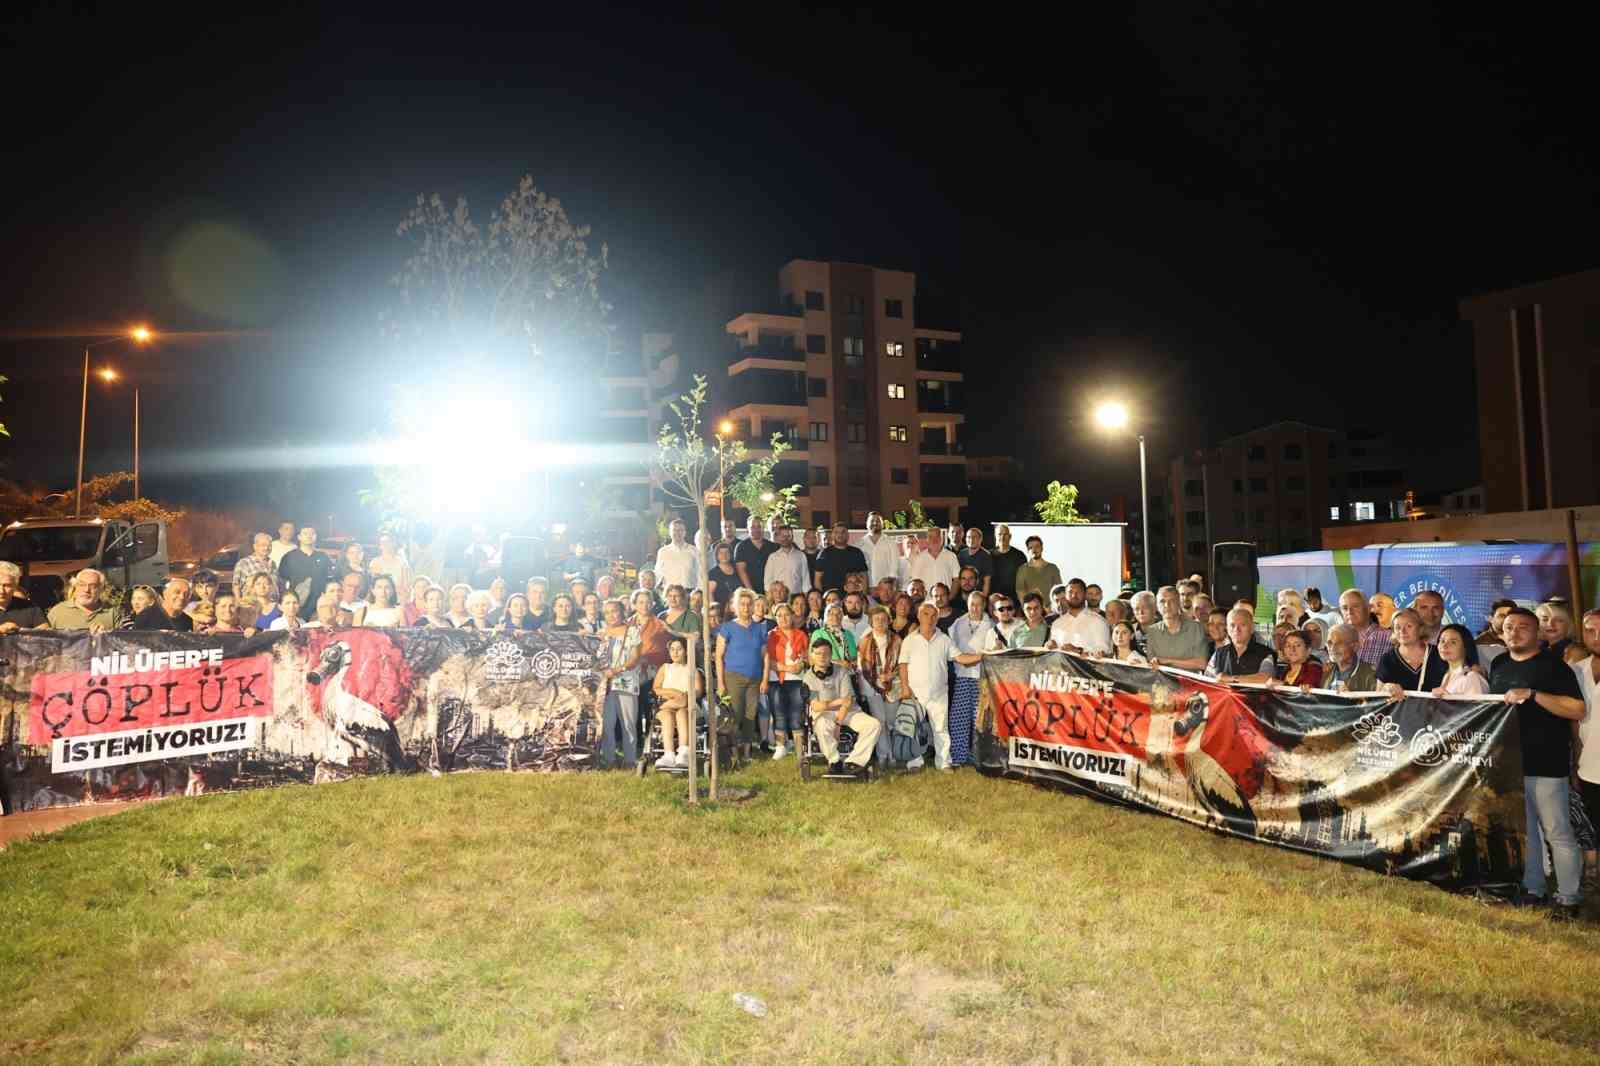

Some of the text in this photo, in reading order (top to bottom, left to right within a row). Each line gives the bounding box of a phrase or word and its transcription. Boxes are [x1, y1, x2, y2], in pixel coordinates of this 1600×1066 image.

[1408, 580, 1467, 624] BELEDİYES
[91, 649, 223, 676] NİLÜFER'E
[42, 667, 265, 738] ÇÖPLÜK
[1029, 672, 1115, 698] NİLÜFER'E
[1002, 690, 1144, 746] ÇÖPLÜK
[63, 721, 247, 764] İSTEMİYORUZ!
[1014, 739, 1127, 777] İSTEMİYORUZ!
